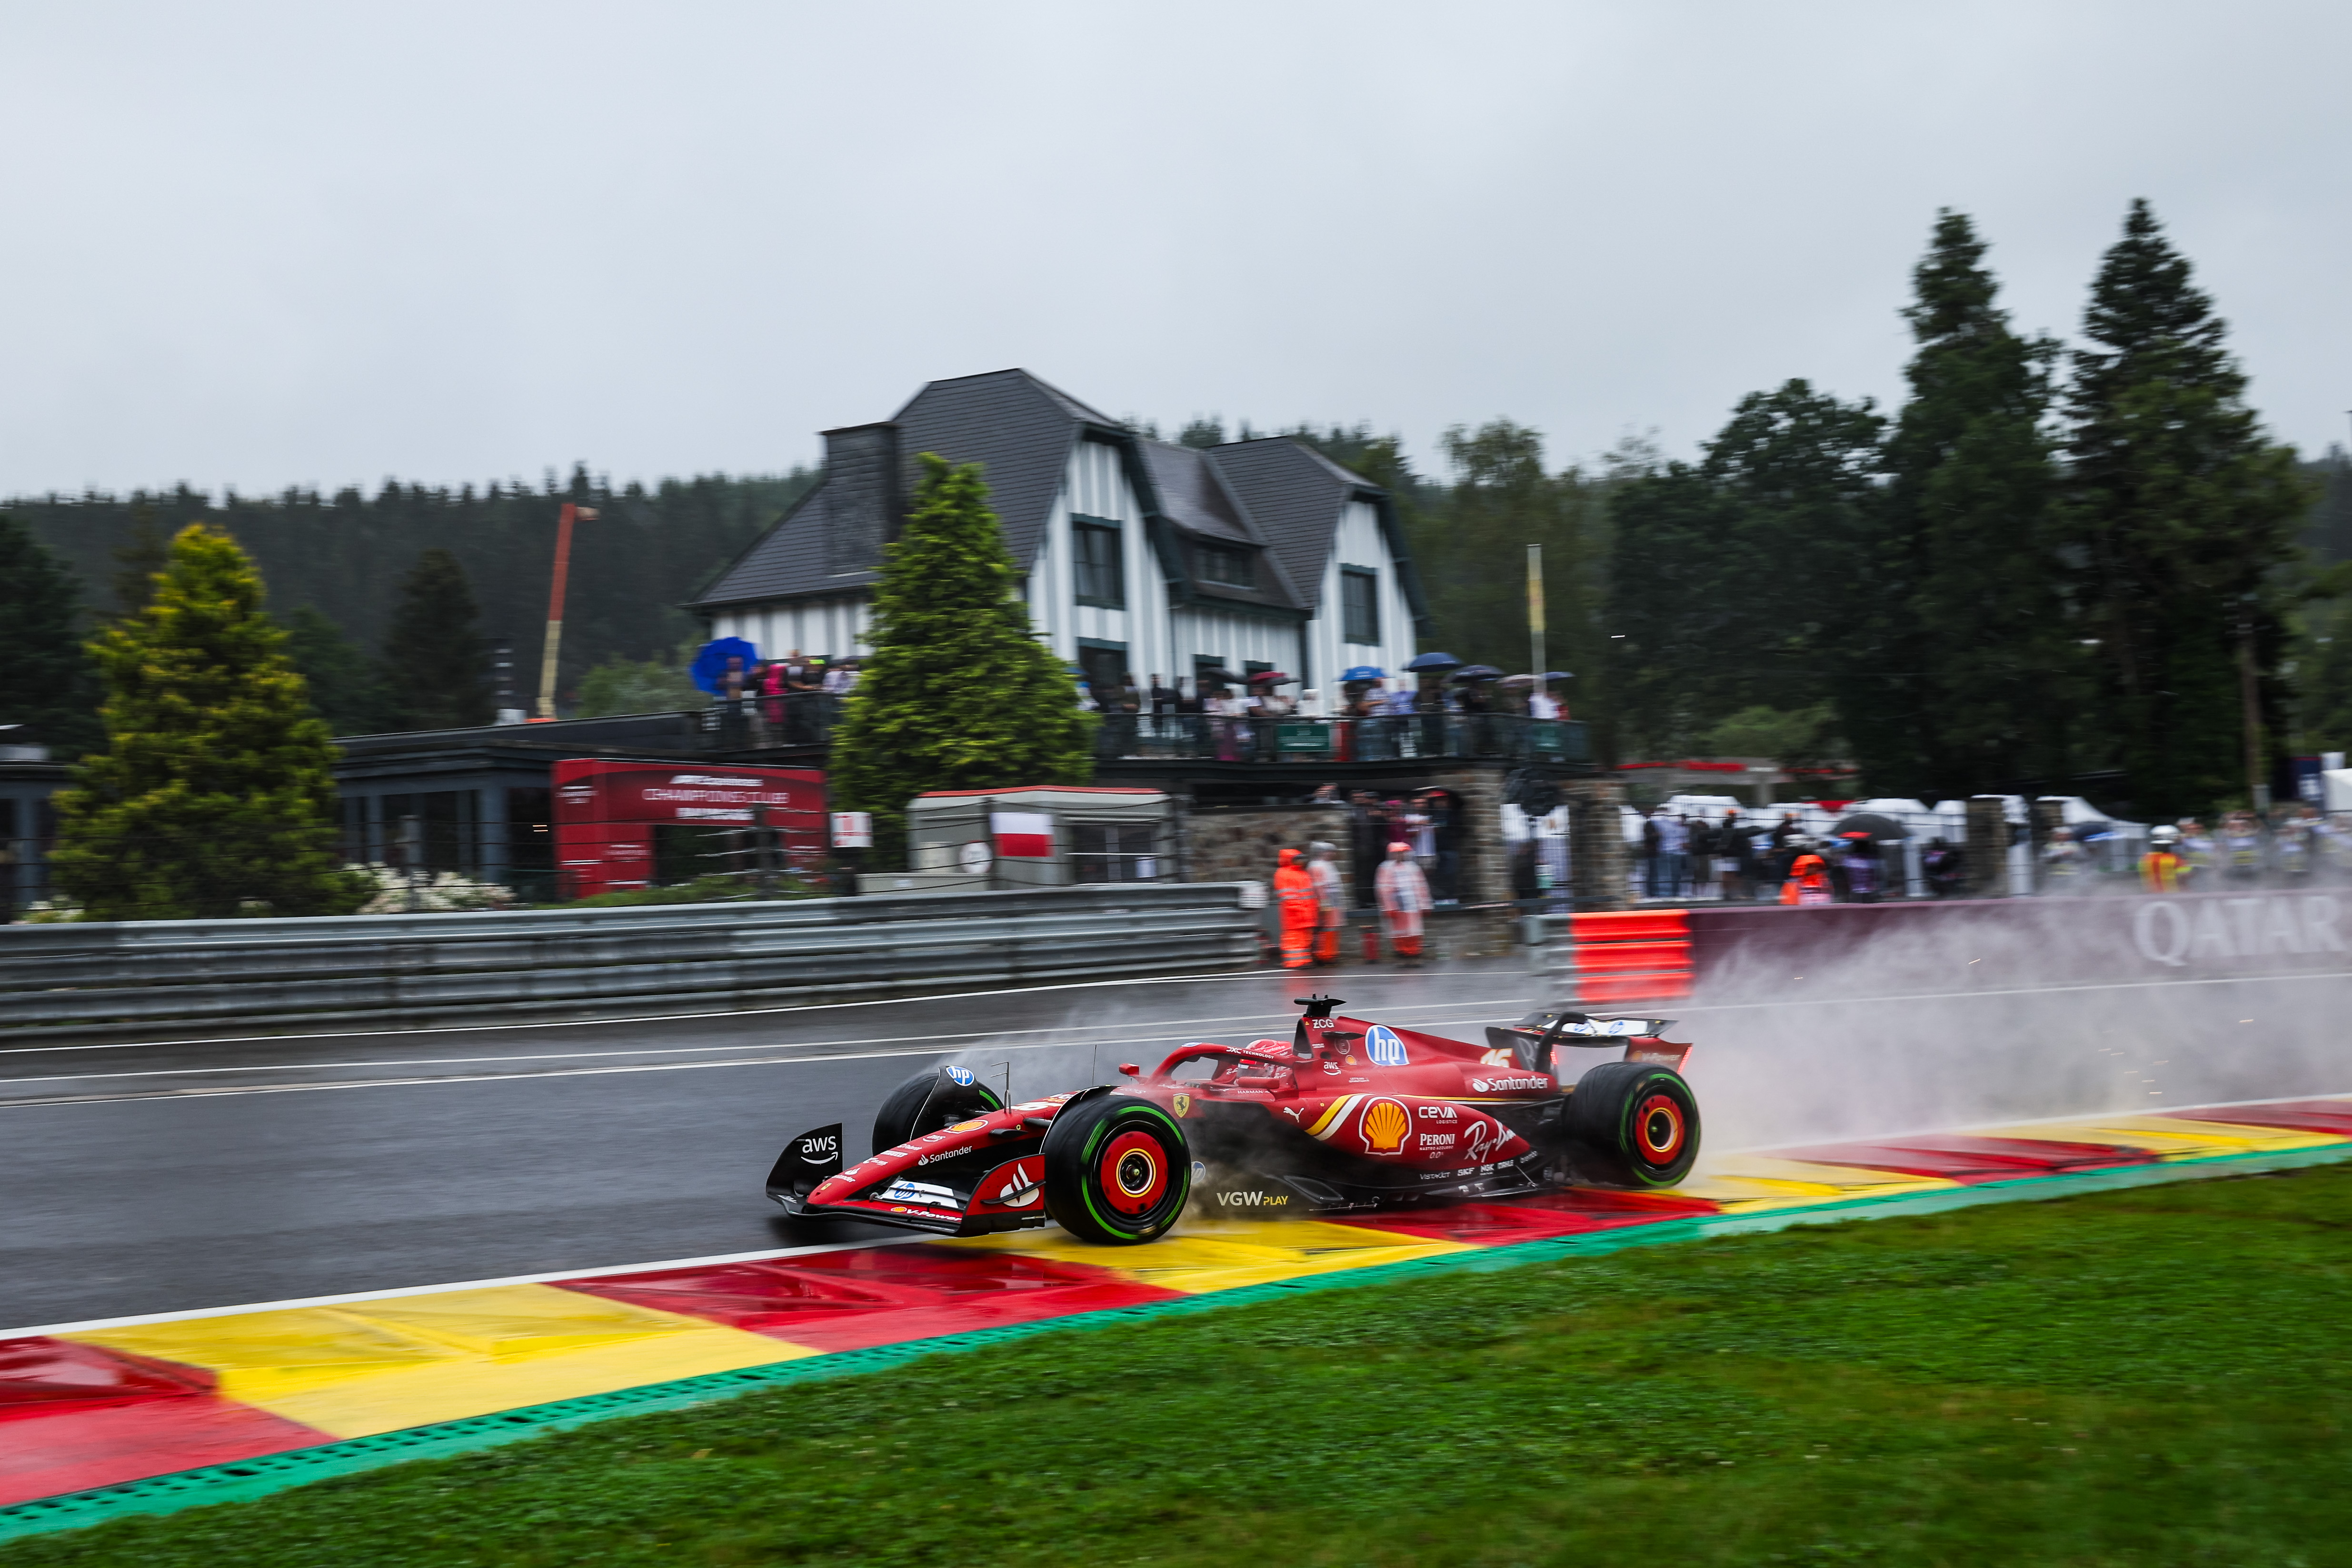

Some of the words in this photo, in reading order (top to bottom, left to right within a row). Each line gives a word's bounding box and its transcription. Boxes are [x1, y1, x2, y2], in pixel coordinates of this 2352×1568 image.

[2134, 895, 2347, 966] QATAR
[1312, 1019, 1334, 1029] ZCG
[1226, 1046, 1242, 1054] DXC
[1243, 1049, 1274, 1059] TECHNOLOGY
[1373, 1026, 1400, 1065] hp
[1324, 1061, 1339, 1069] aws
[951, 1066, 970, 1085] hp
[1486, 1075, 1548, 1091] Santander
[802, 1136, 837, 1153] aws
[1419, 1133, 1455, 1146] PERONI
[930, 1146, 972, 1163] Santander
[1457, 1168, 1475, 1176] SKF
[1216, 1191, 1263, 1206] VGW
[1264, 1196, 1288, 1206] PLAY
[907, 1209, 962, 1221] V-Power
